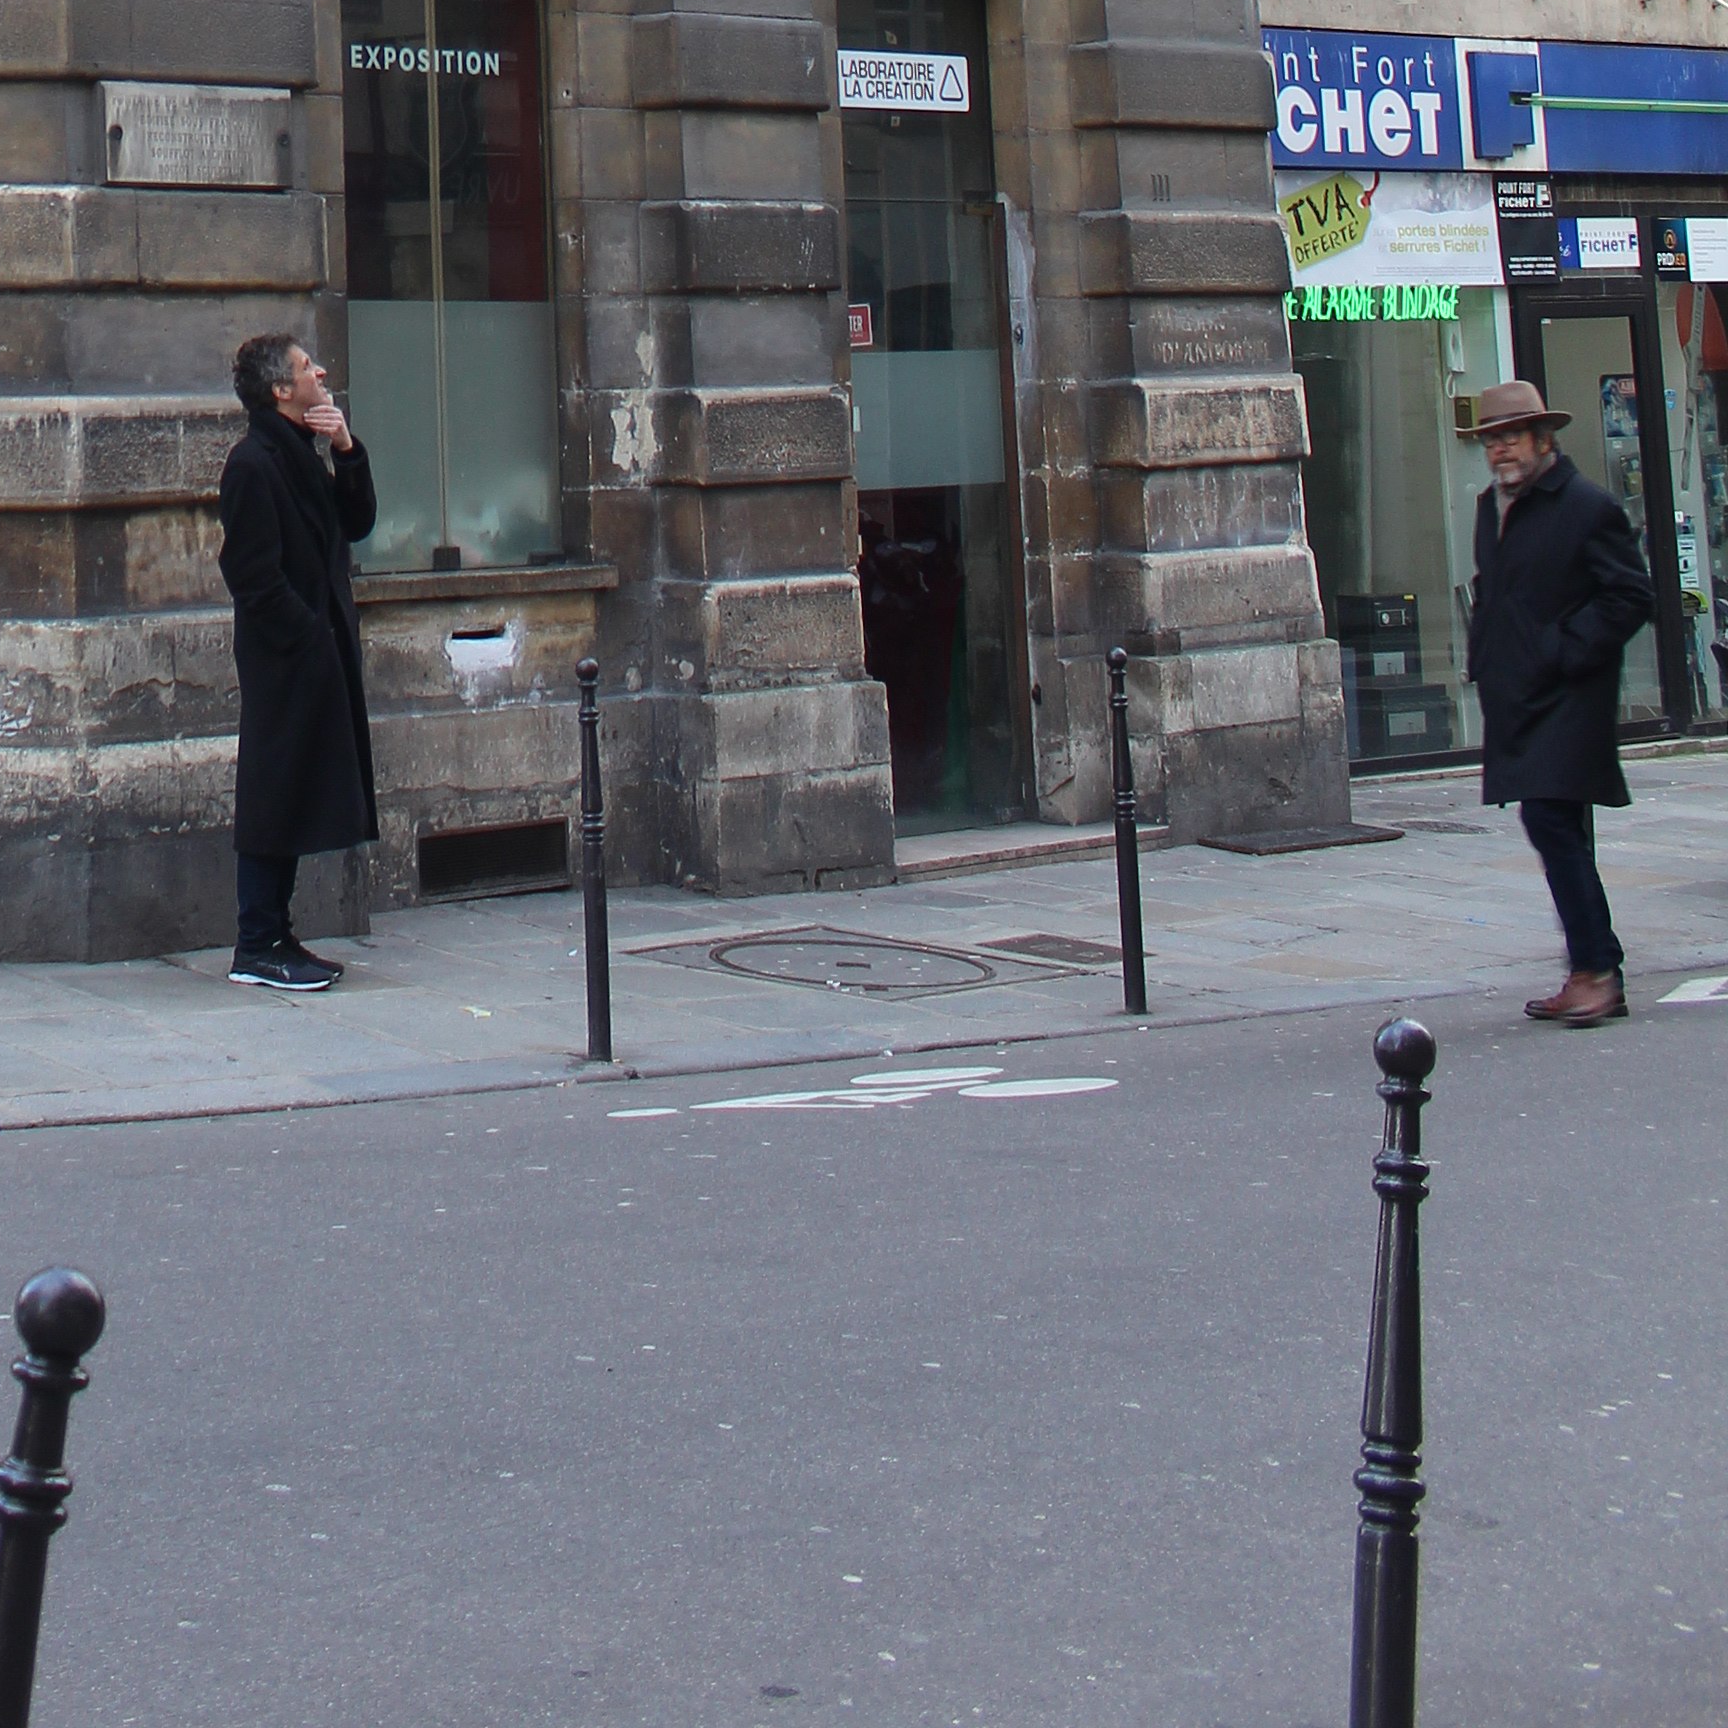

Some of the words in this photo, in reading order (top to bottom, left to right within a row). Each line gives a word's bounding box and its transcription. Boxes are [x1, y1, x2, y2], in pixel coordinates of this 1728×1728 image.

[350, 44, 500, 76] EXPOSITION
[840, 59, 935, 81] LABORATOIRE
[1351, 46, 1436, 86] Fort
[844, 79, 862, 98] LA
[866, 81, 934, 101] CREATION
[1286, 183, 1355, 236] TVA
[1397, 224, 1436, 239] portes
[1438, 223, 1489, 237] blindées
[1389, 241, 1440, 253] serrures
[1443, 239, 1479, 253] Fichet
[1382, 284, 1461, 321] BLINDAGE
